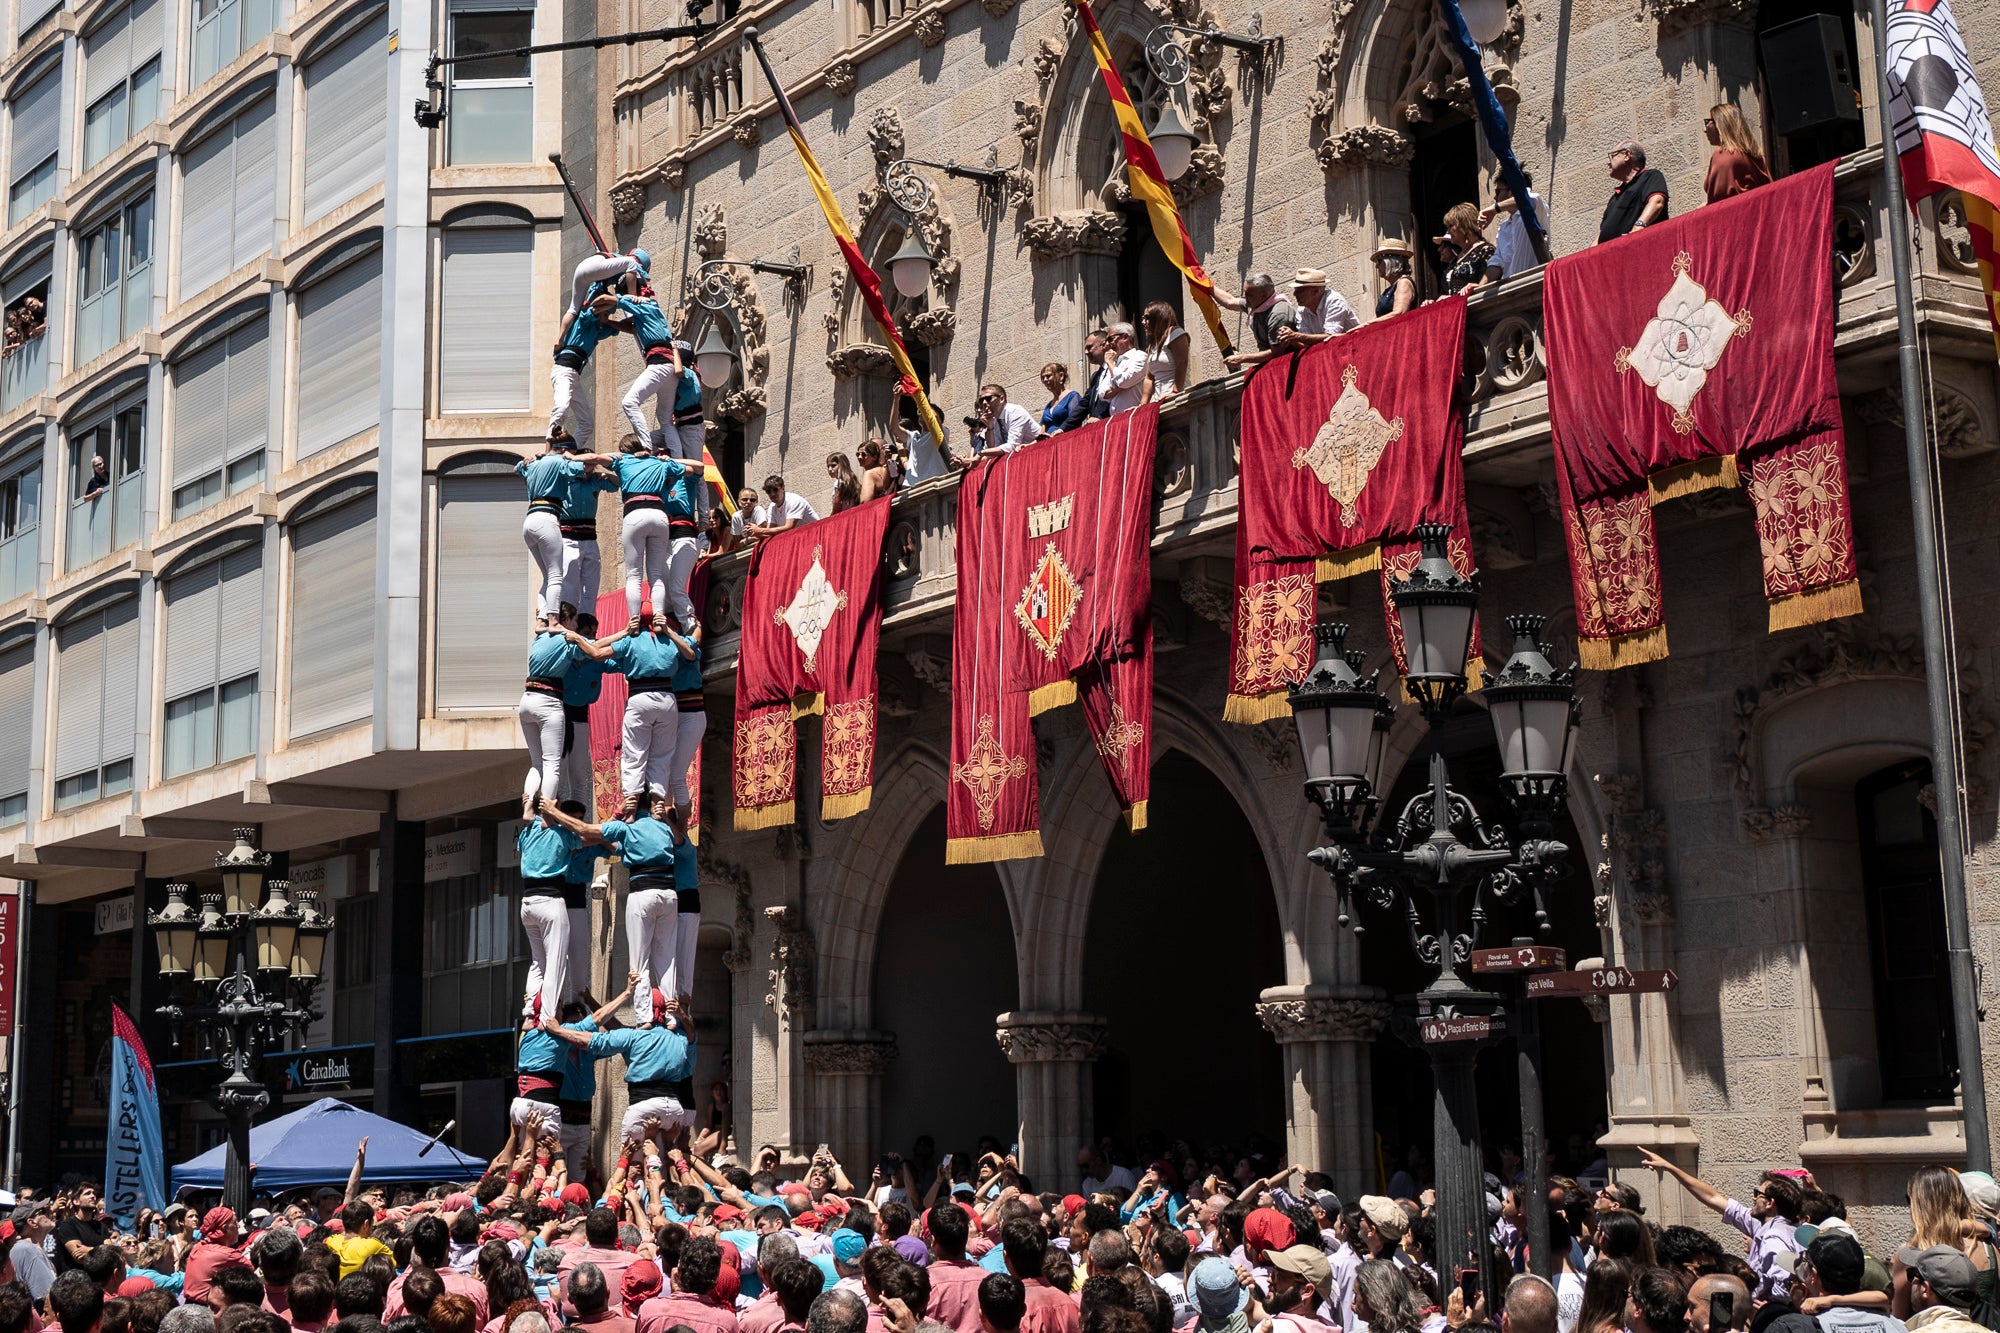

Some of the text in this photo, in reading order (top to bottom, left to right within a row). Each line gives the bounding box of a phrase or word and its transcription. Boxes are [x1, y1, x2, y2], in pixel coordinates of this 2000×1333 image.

[290, 865, 325, 884] Advocats
[1538, 978, 1554, 989] Vella
[1447, 1024, 1461, 1035] Plaça
[303, 1057, 350, 1080] CaixaBank
[111, 1101, 142, 1230] CASTELLERS
